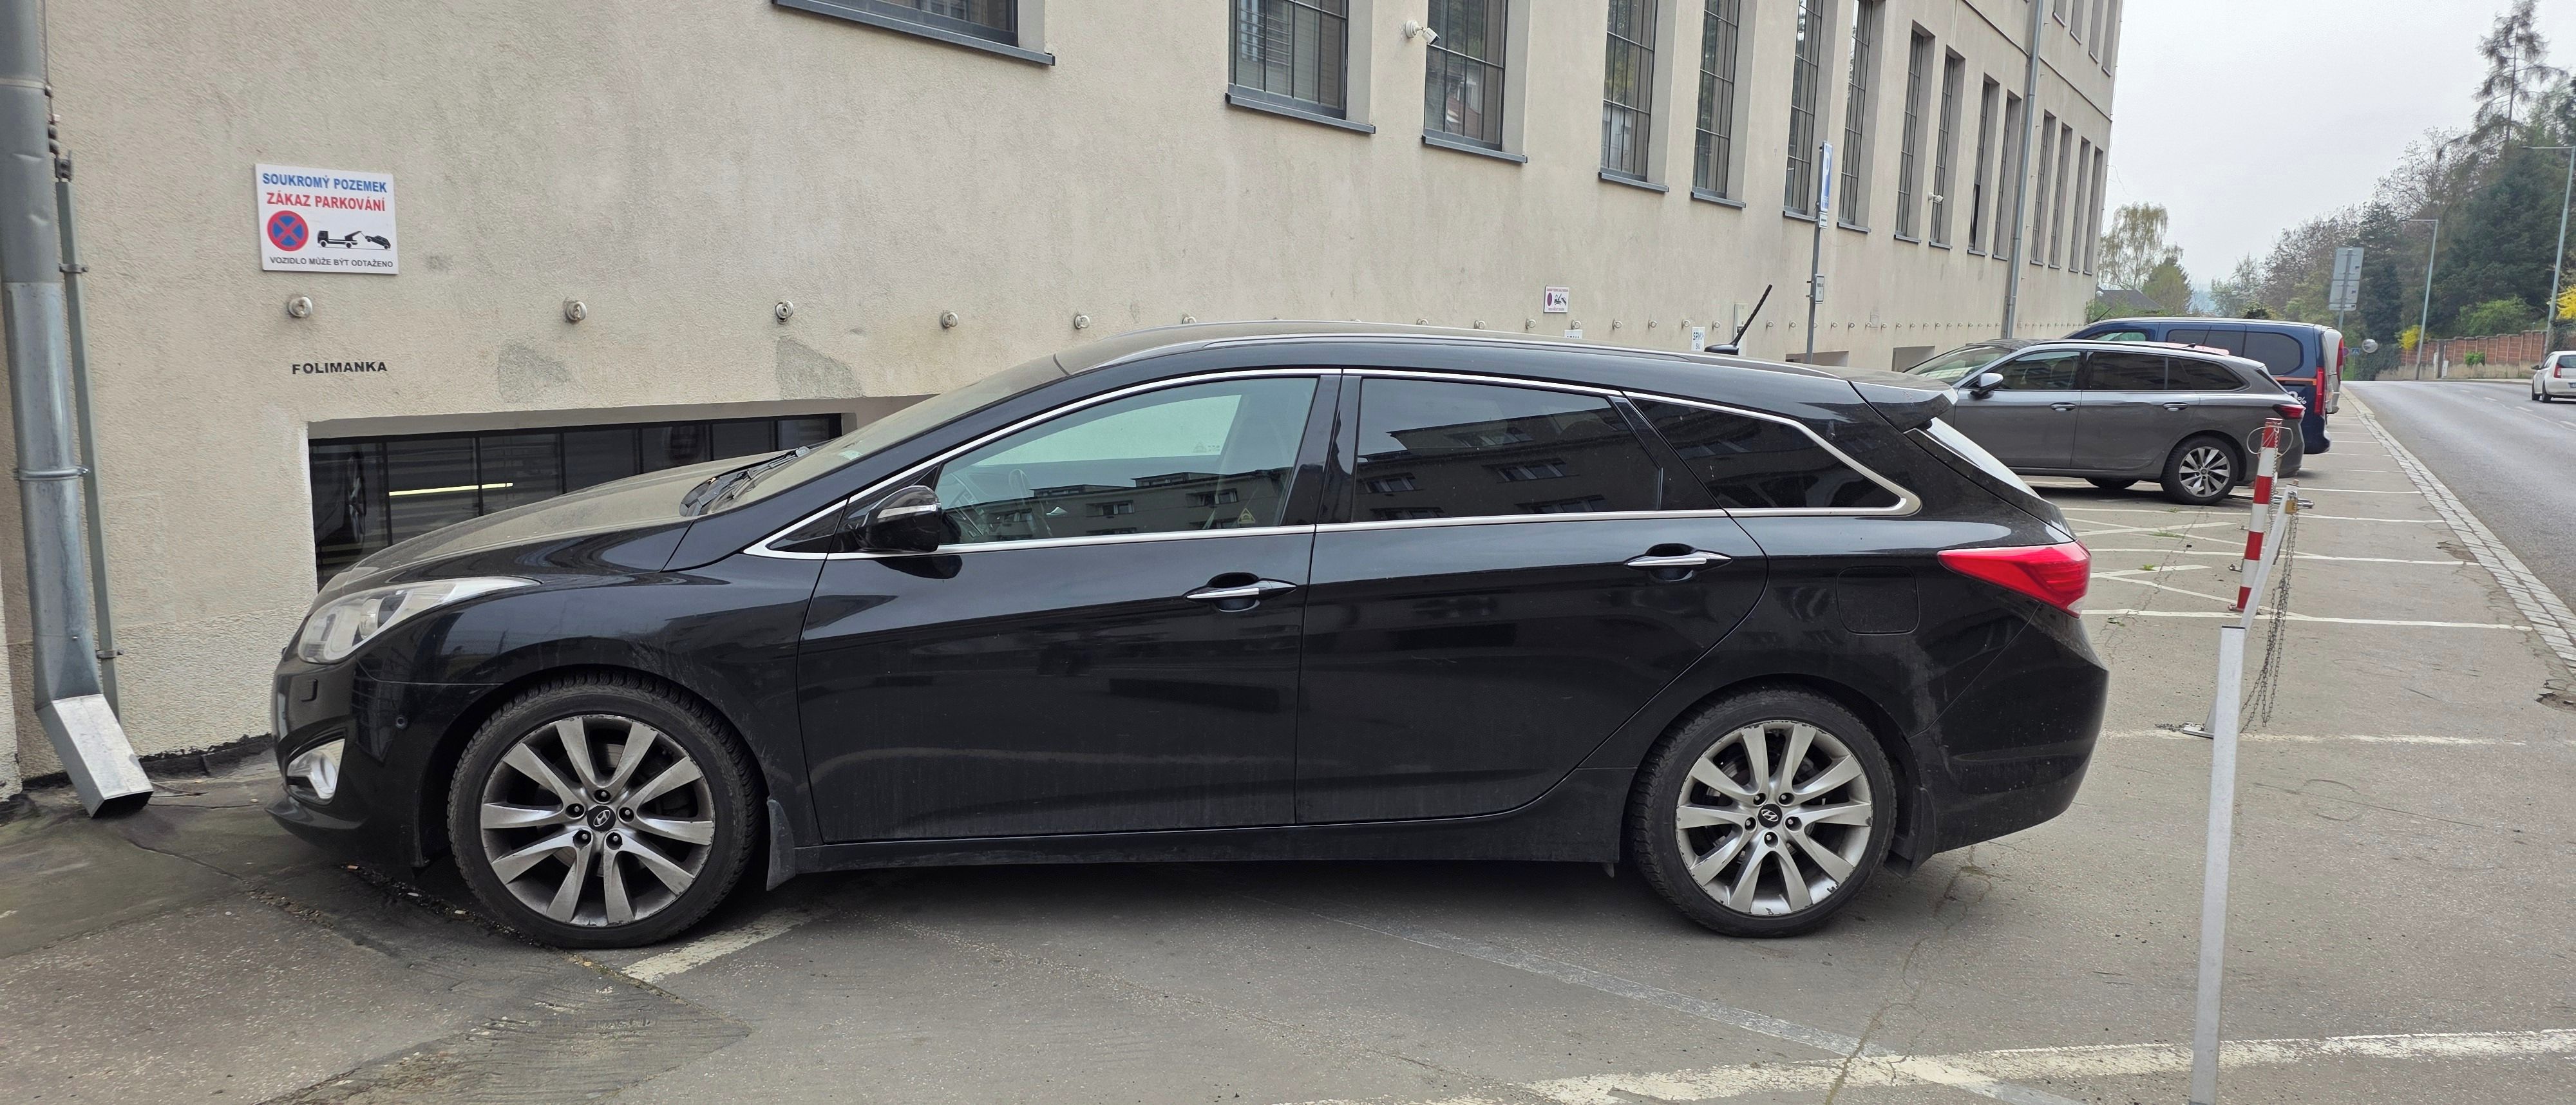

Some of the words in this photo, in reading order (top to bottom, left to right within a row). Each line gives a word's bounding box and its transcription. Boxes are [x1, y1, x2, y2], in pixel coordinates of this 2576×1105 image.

[262, 173, 330, 188] SOUKROMÝ
[334, 178, 387, 193] POZEMEK
[267, 190, 310, 207] ZÁKAZ
[315, 194, 385, 211] PARKOVÁNÍ
[269, 256, 307, 265] VOZIDLO
[309, 257, 331, 265] MŮŽE
[351, 259, 393, 267] ODTAŽENO
[292, 361, 387, 374] FOLIMANKA
